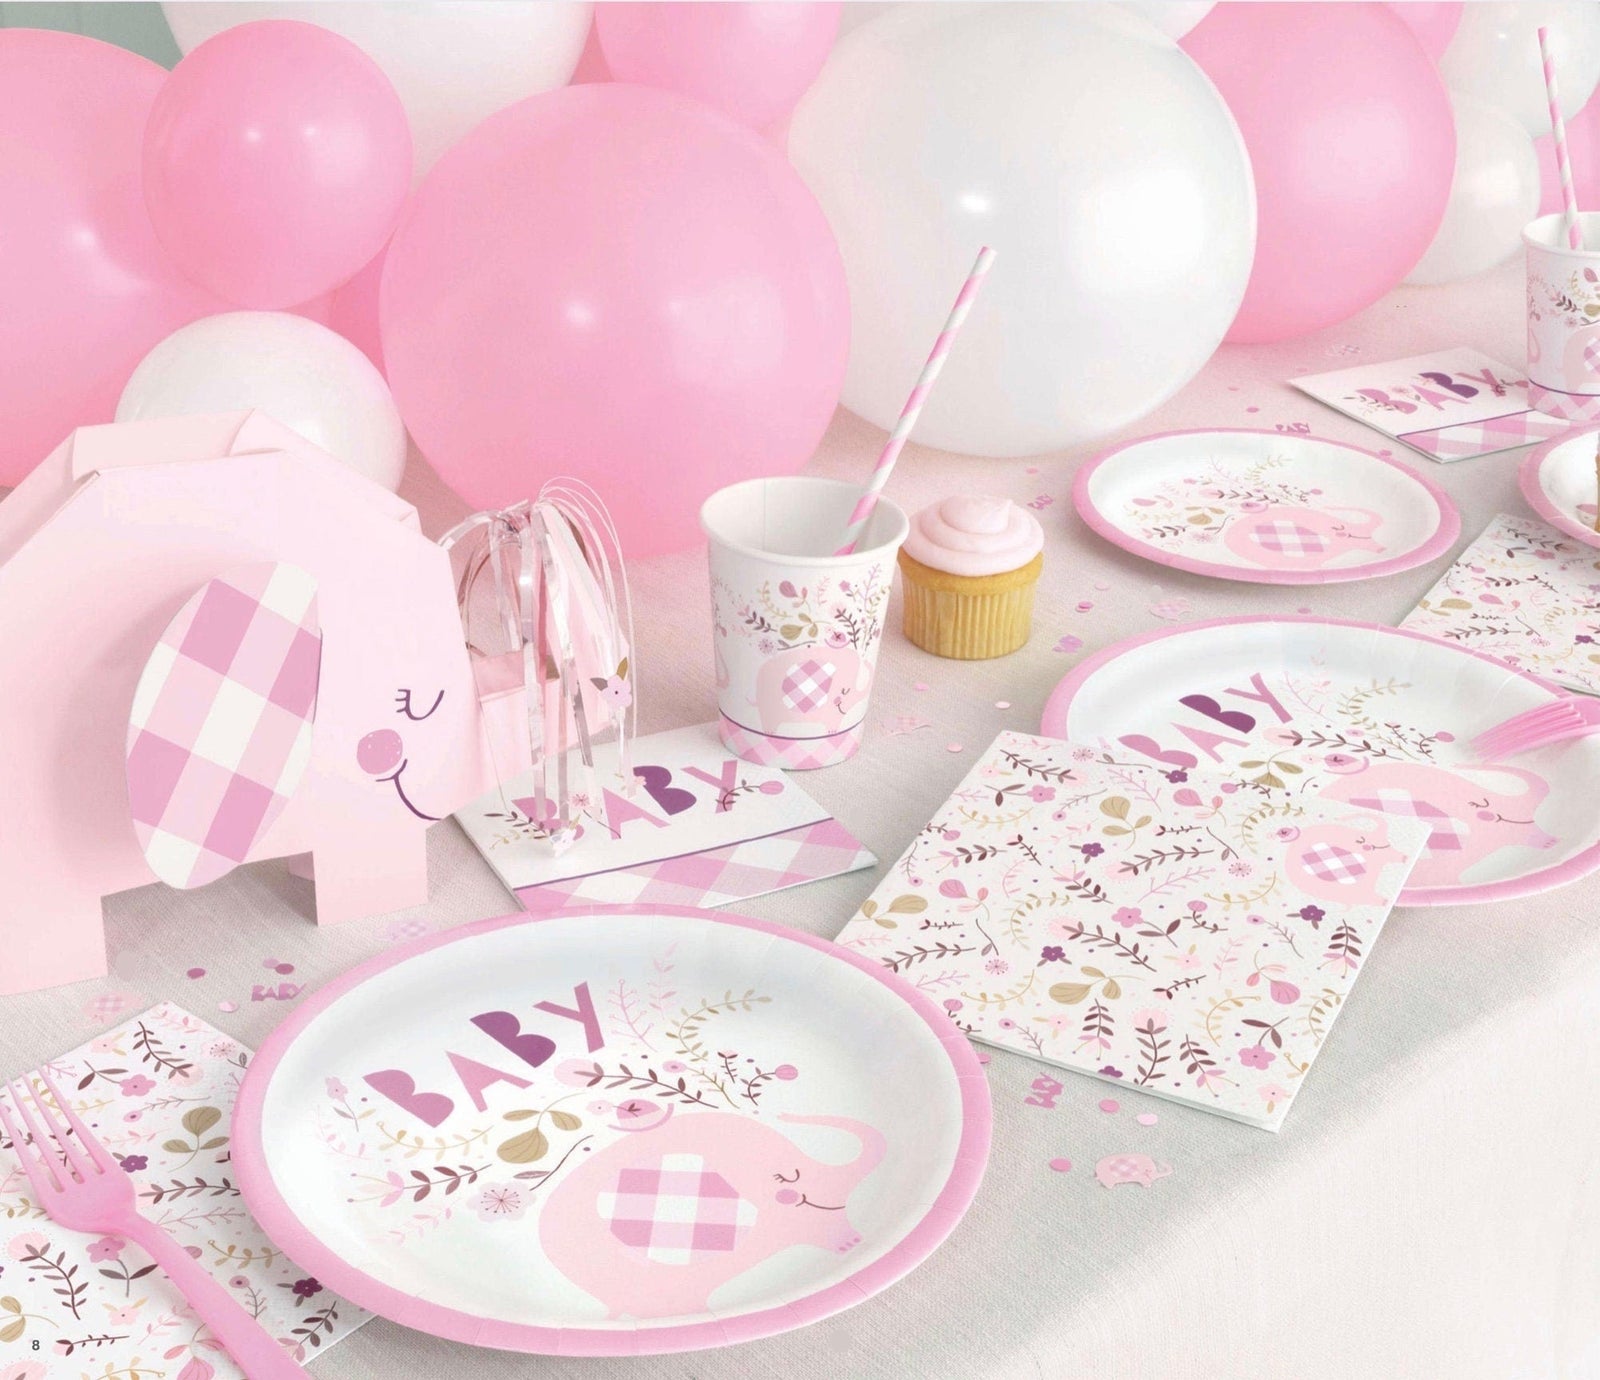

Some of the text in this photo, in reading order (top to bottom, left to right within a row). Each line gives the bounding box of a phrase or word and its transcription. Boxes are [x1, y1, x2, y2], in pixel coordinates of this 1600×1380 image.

[1356, 368, 1506, 415] BABY
[1117, 672, 1293, 769] BABY
[511, 760, 738, 840] BABY
[362, 981, 605, 1128] BABY
